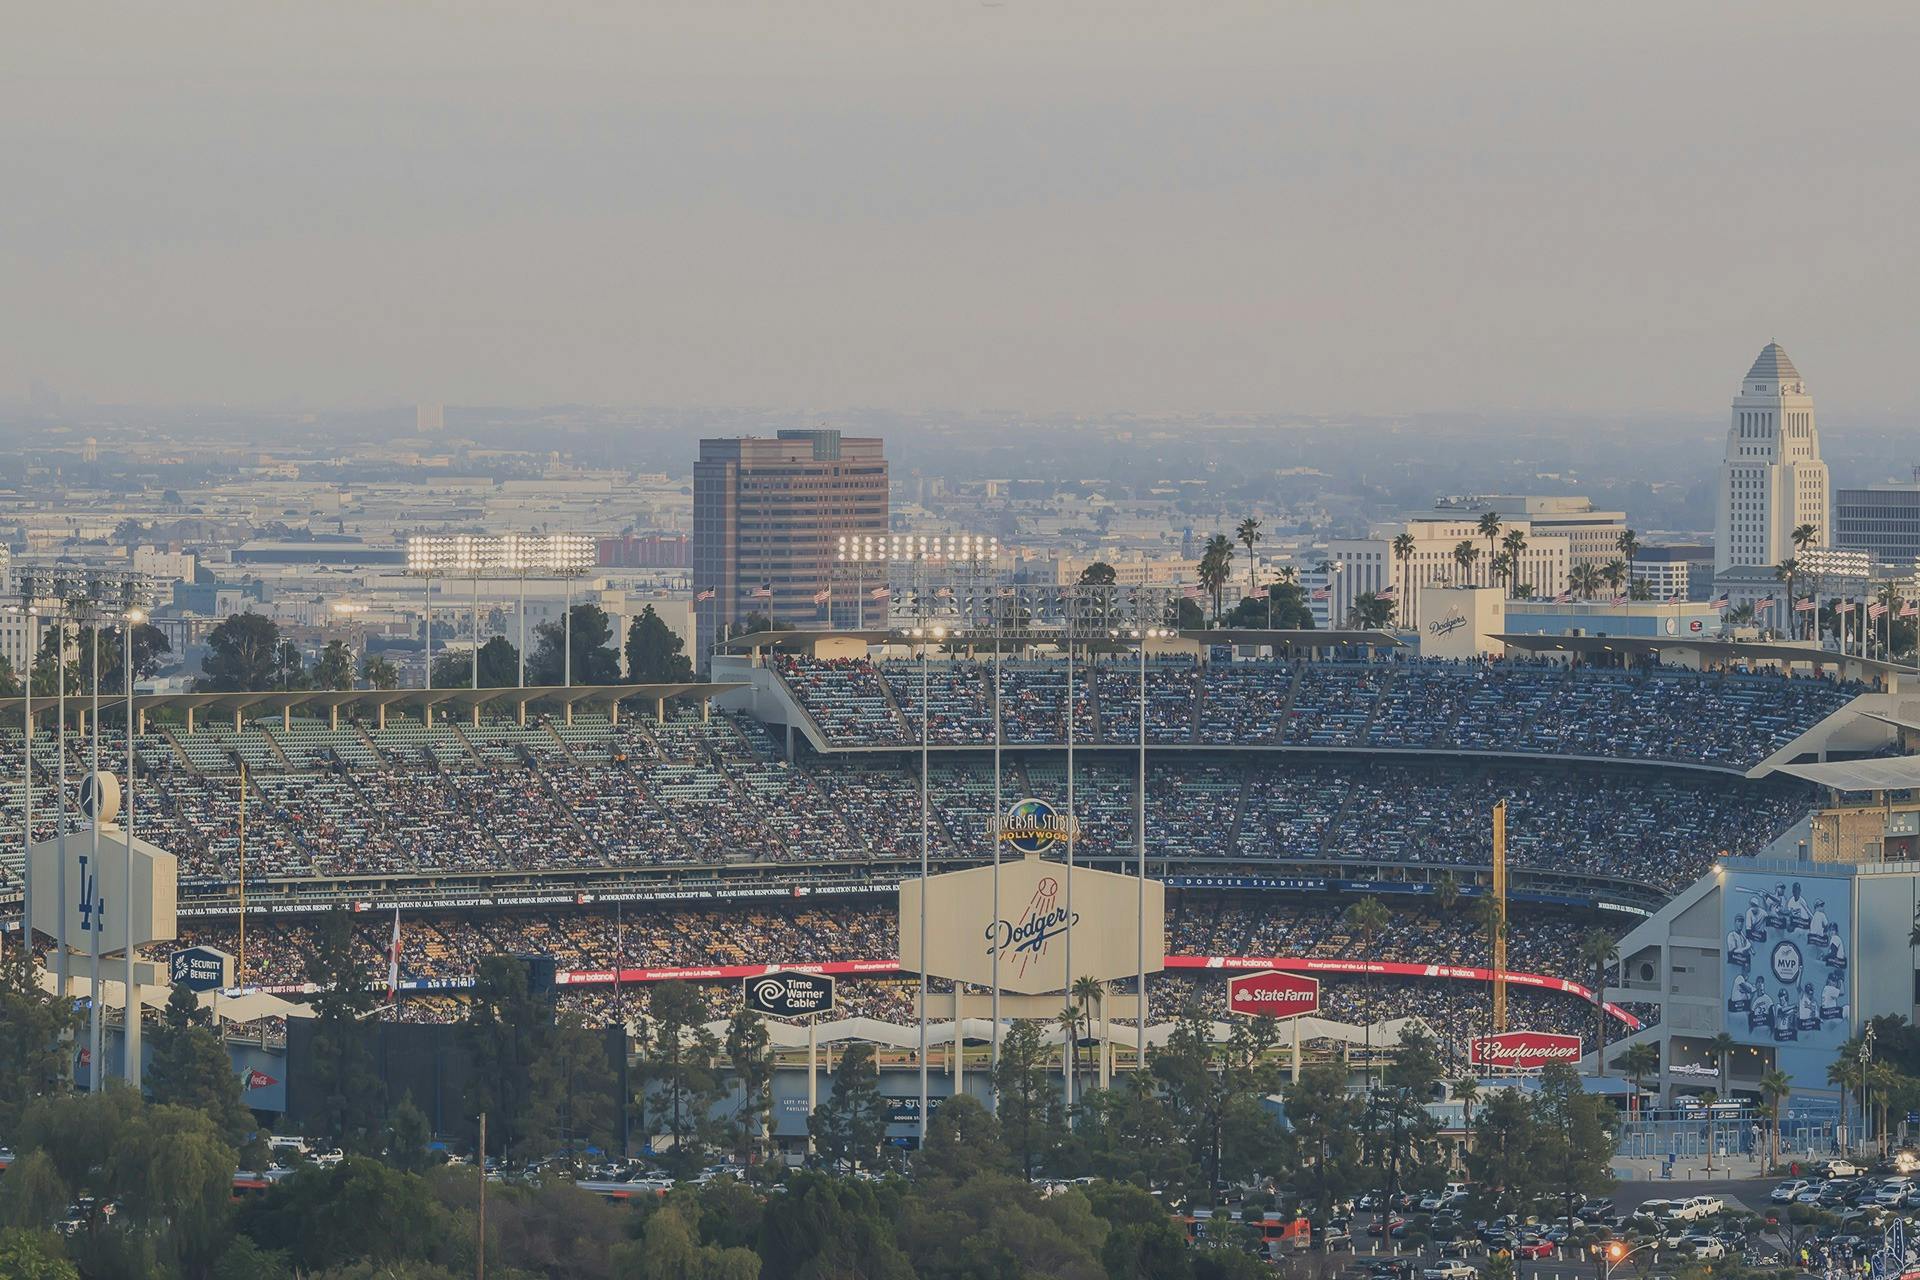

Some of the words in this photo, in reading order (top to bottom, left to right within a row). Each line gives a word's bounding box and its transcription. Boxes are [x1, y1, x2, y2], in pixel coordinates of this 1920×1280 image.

[1429, 616, 1467, 636] Dodgers
[1186, 878, 1242, 886] DODGER
[815, 886, 851, 894] MODERATION
[599, 893, 636, 901] MODERATION
[985, 907, 1079, 955] Dodgers
[190, 959, 220, 970] SECURITY
[1778, 959, 1796, 969] MVP
[190, 969, 217, 980] BENEFIT
[787, 980, 813, 989] Time
[787, 989, 825, 999] Warner
[787, 999, 816, 1008] Cable
[1474, 1042, 1578, 1060] Budweiser
[905, 1099, 943, 1108] STUIOS
